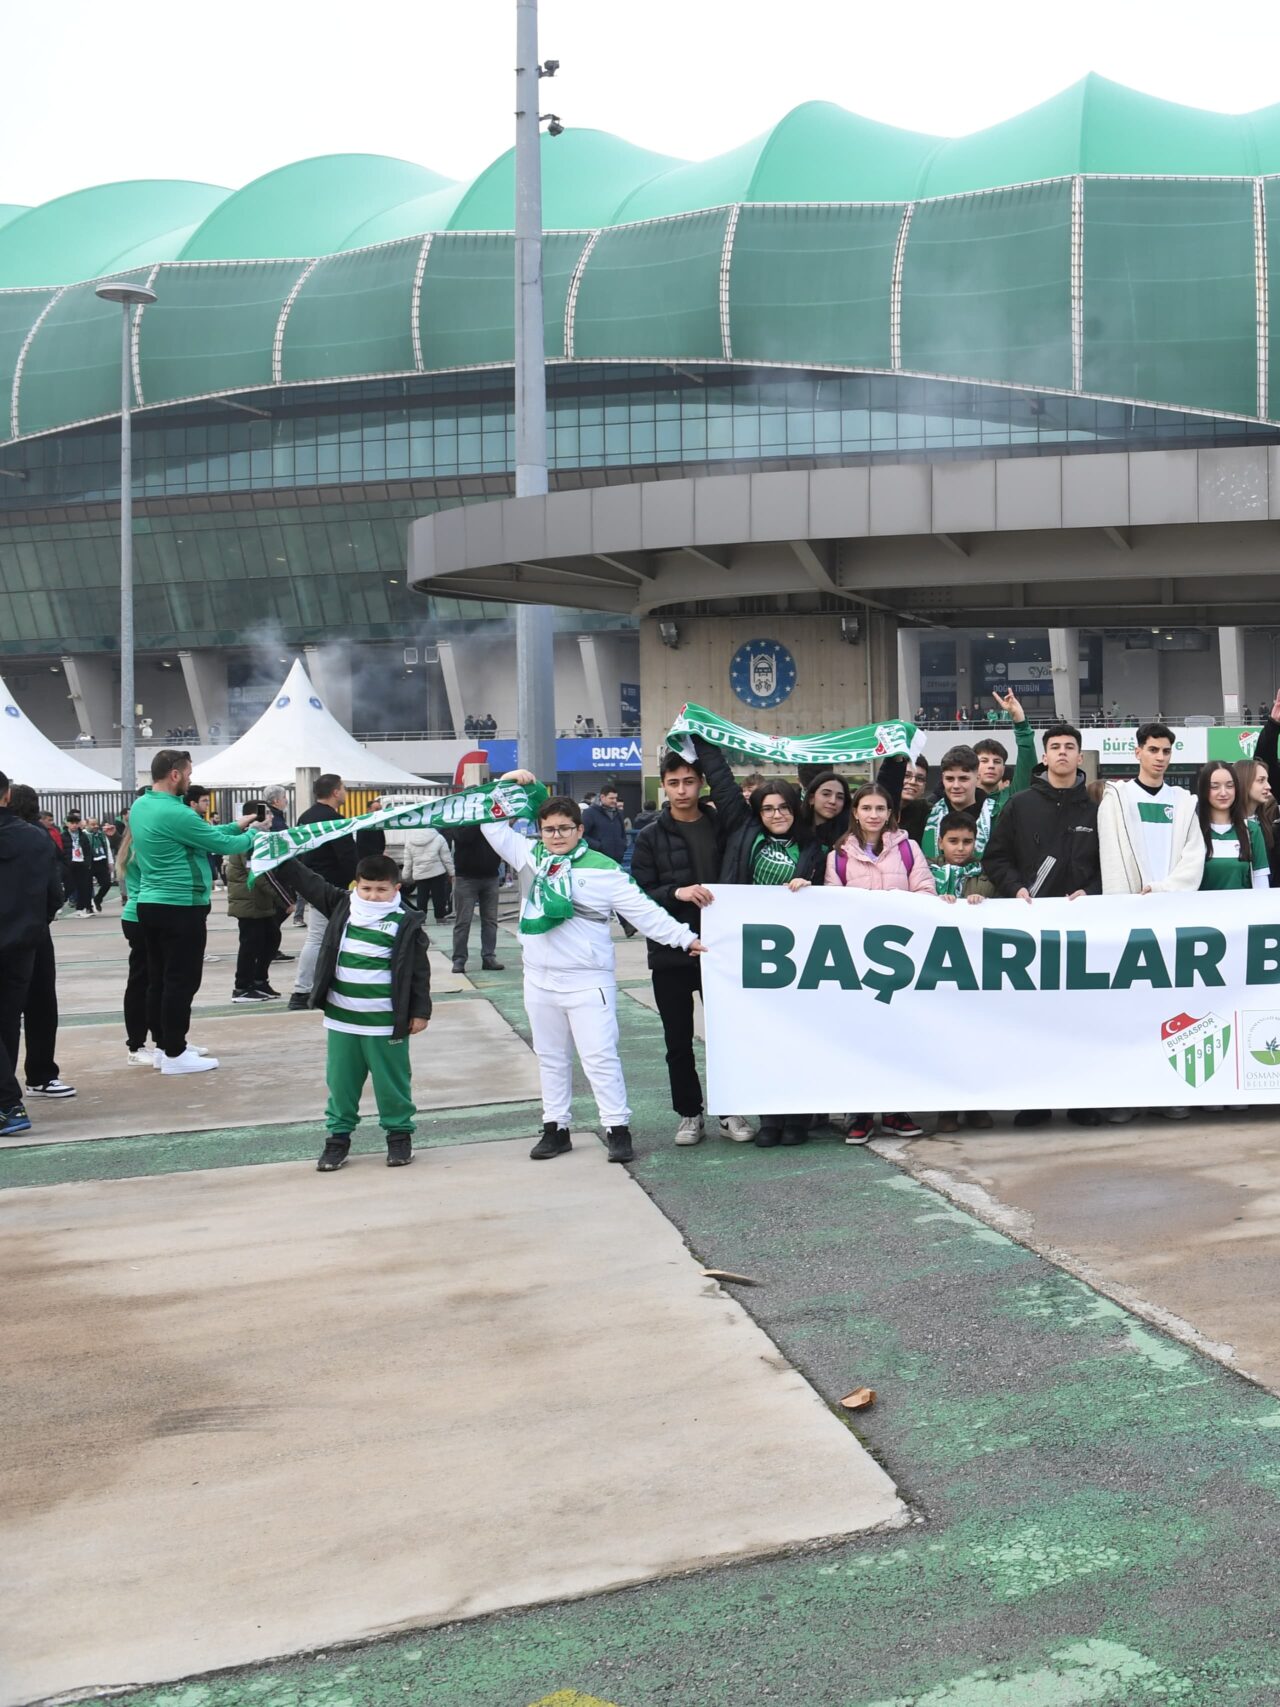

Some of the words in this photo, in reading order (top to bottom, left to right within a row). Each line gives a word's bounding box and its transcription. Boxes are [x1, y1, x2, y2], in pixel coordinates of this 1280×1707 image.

[687, 721, 875, 763] BURSASPOR
[741, 923, 1228, 1005] BAŞARILAR
[1166, 1017, 1215, 1048] BURSASPOR
[1186, 1038, 1221, 1065] 1963
